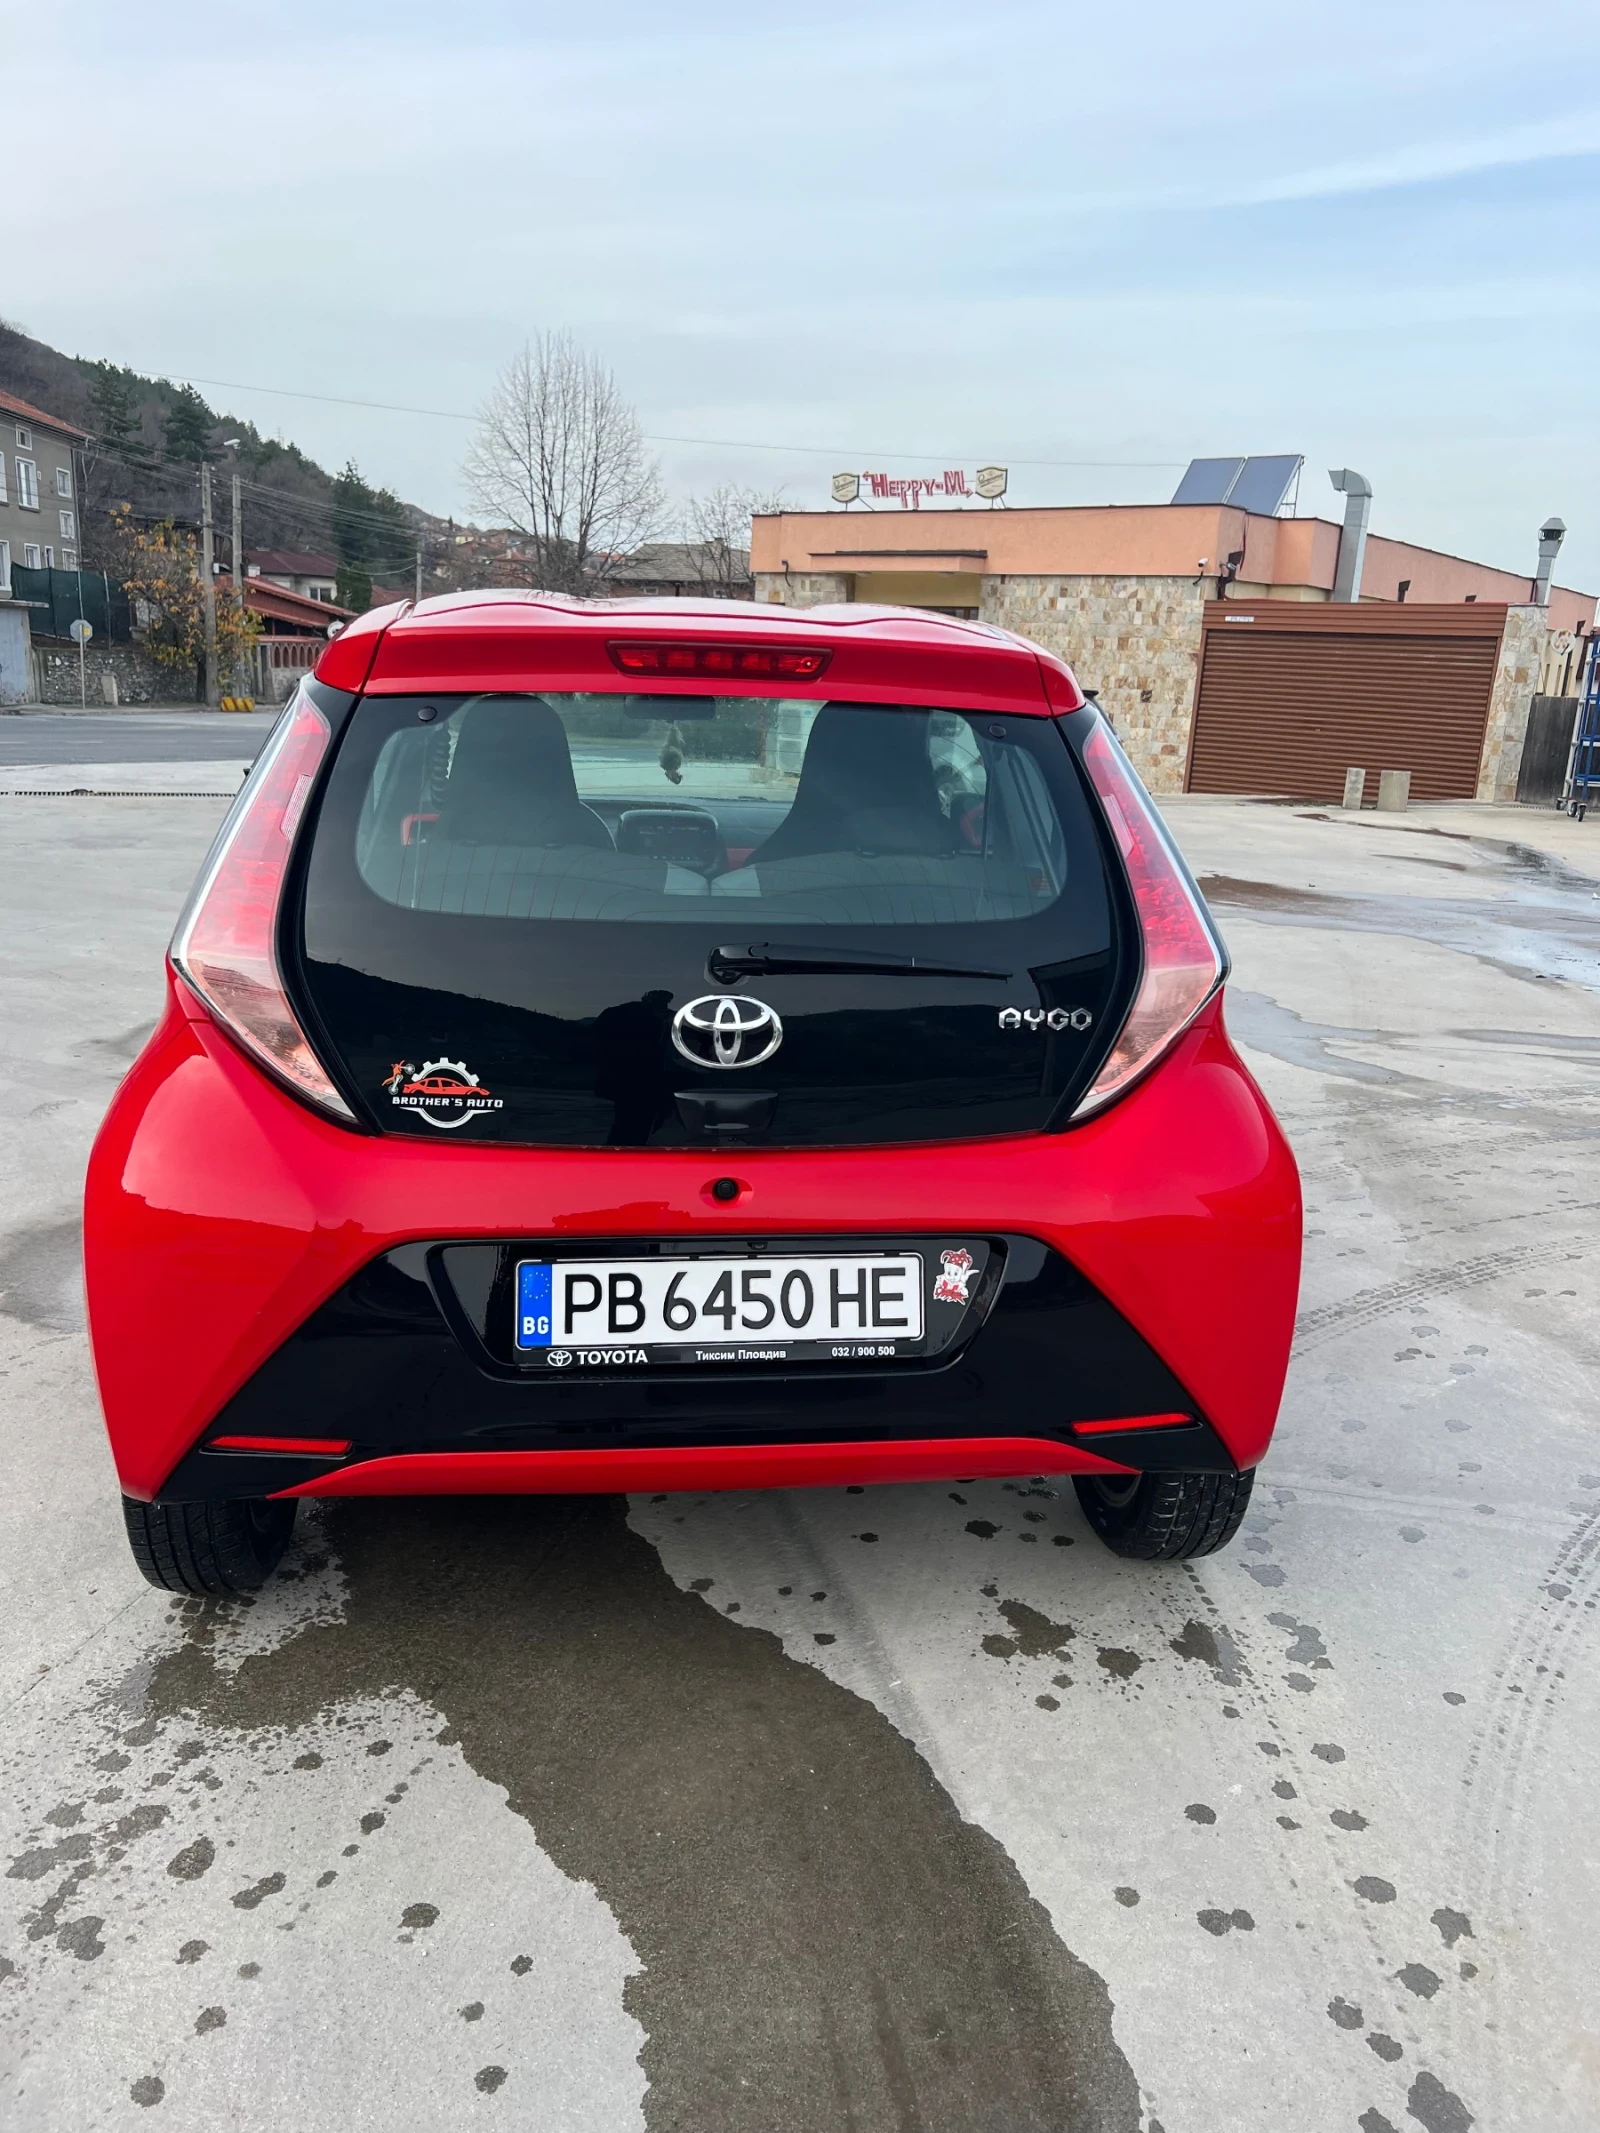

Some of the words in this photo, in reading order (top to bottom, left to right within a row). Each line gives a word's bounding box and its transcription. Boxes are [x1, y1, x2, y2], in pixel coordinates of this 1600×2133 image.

[998, 1007, 1092, 1031] AYGO
[392, 1096, 463, 1107] BROTHER'S
[467, 1099, 504, 1108] AUTO
[564, 1272, 646, 1334] PB
[662, 1268, 814, 1331] 6450
[829, 1267, 909, 1328] HE
[523, 1316, 549, 1335] BG
[576, 1350, 649, 1365] TOYOTA
[695, 1350, 735, 1361] Тиксим
[738, 1349, 787, 1361] Пловдив
[831, 1347, 849, 1357] 032
[851, 1347, 856, 1357] /
[857, 1346, 875, 1357] 900
[877, 1346, 896, 1356] 500
